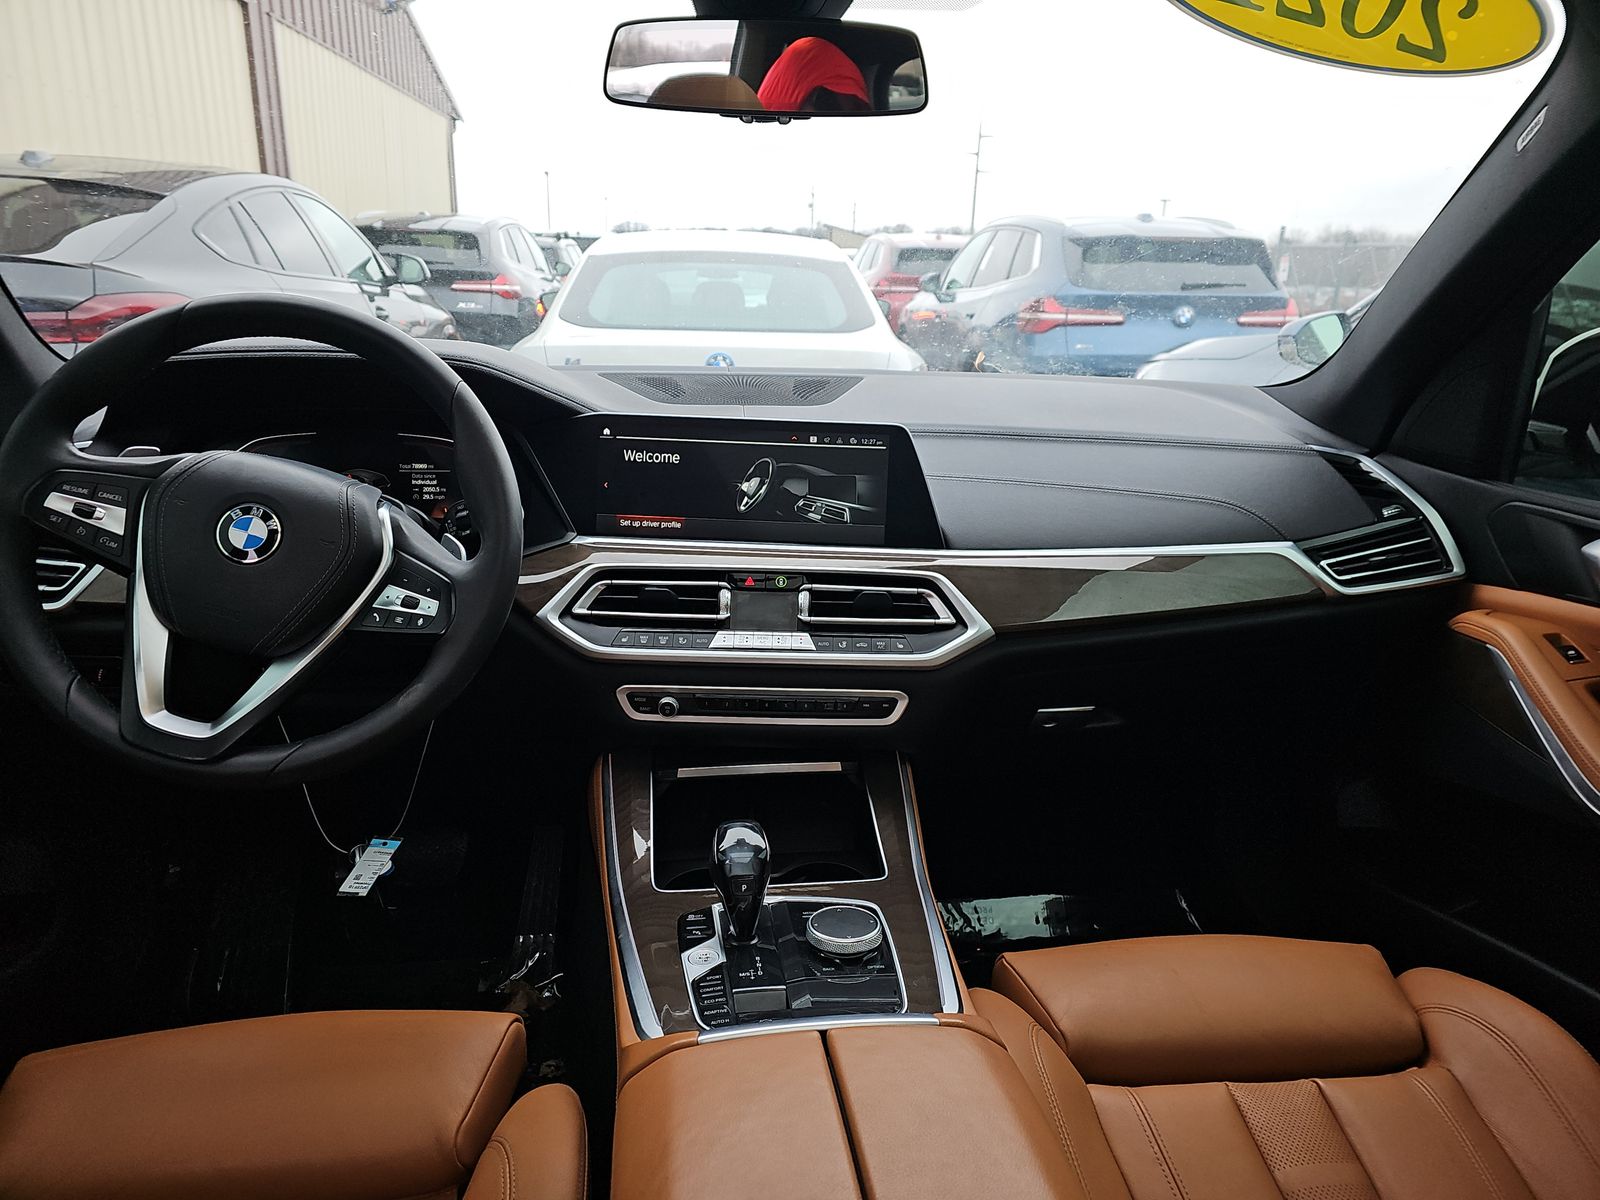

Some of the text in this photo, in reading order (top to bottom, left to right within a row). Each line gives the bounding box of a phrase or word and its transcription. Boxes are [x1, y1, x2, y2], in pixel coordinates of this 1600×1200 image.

[623, 449, 681, 464] Welcome
[62, 484, 90, 495] RESUME
[97, 491, 122, 502] CANCEL
[49, 514, 63, 523] SET
[230, 506, 278, 530] BMW
[620, 519, 682, 529] Set up driver profile
[741, 884, 747, 892] P
[699, 985, 724, 993] COMFORT
[703, 1008, 728, 1016] ADAPTIVE
